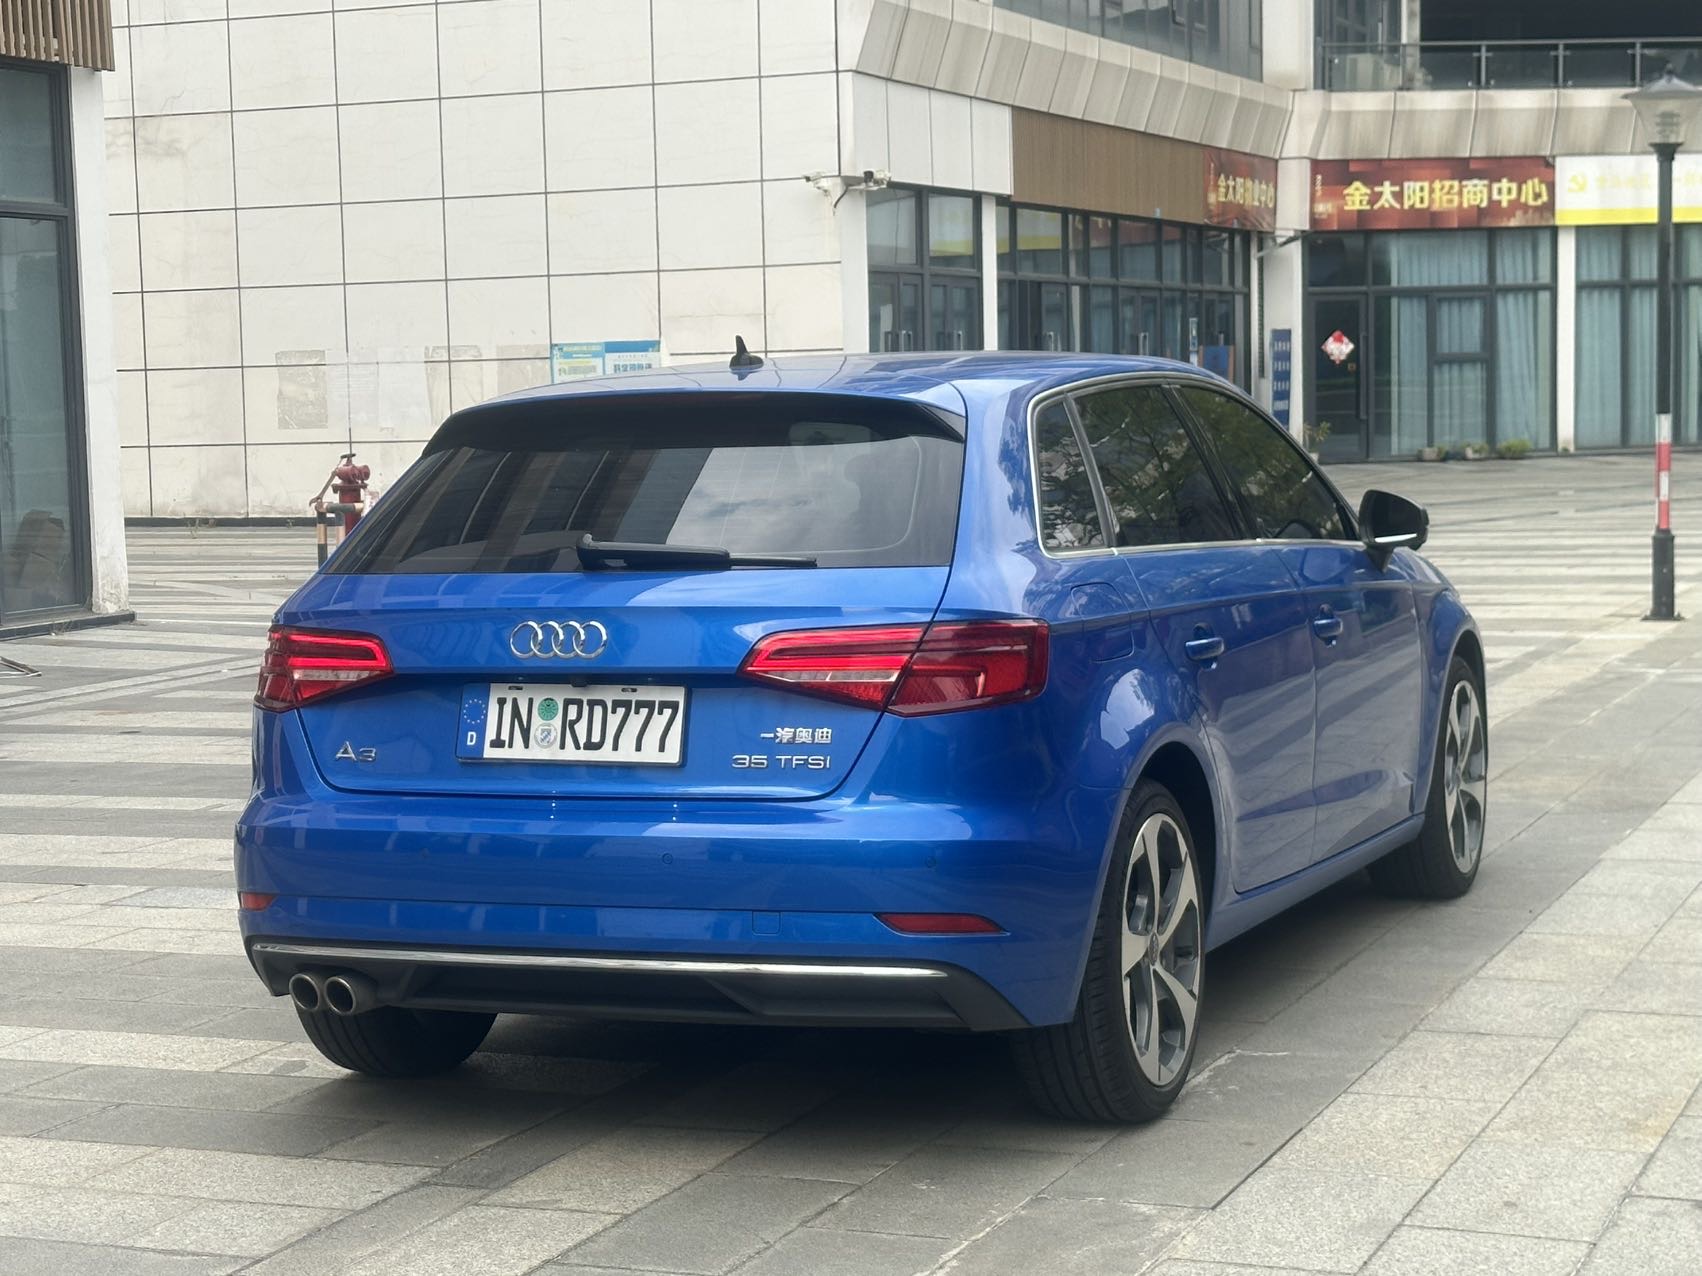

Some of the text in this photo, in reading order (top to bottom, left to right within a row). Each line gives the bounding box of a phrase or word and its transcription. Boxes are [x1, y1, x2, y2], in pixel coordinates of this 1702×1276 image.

[1343, 177, 1548, 211] 金太阳招商中心
[489, 696, 680, 753] IN RD777
[466, 731, 477, 746] D
[760, 727, 832, 744] 一汽奥迪
[335, 740, 377, 762] A3
[731, 754, 831, 769] 35 TFSI
